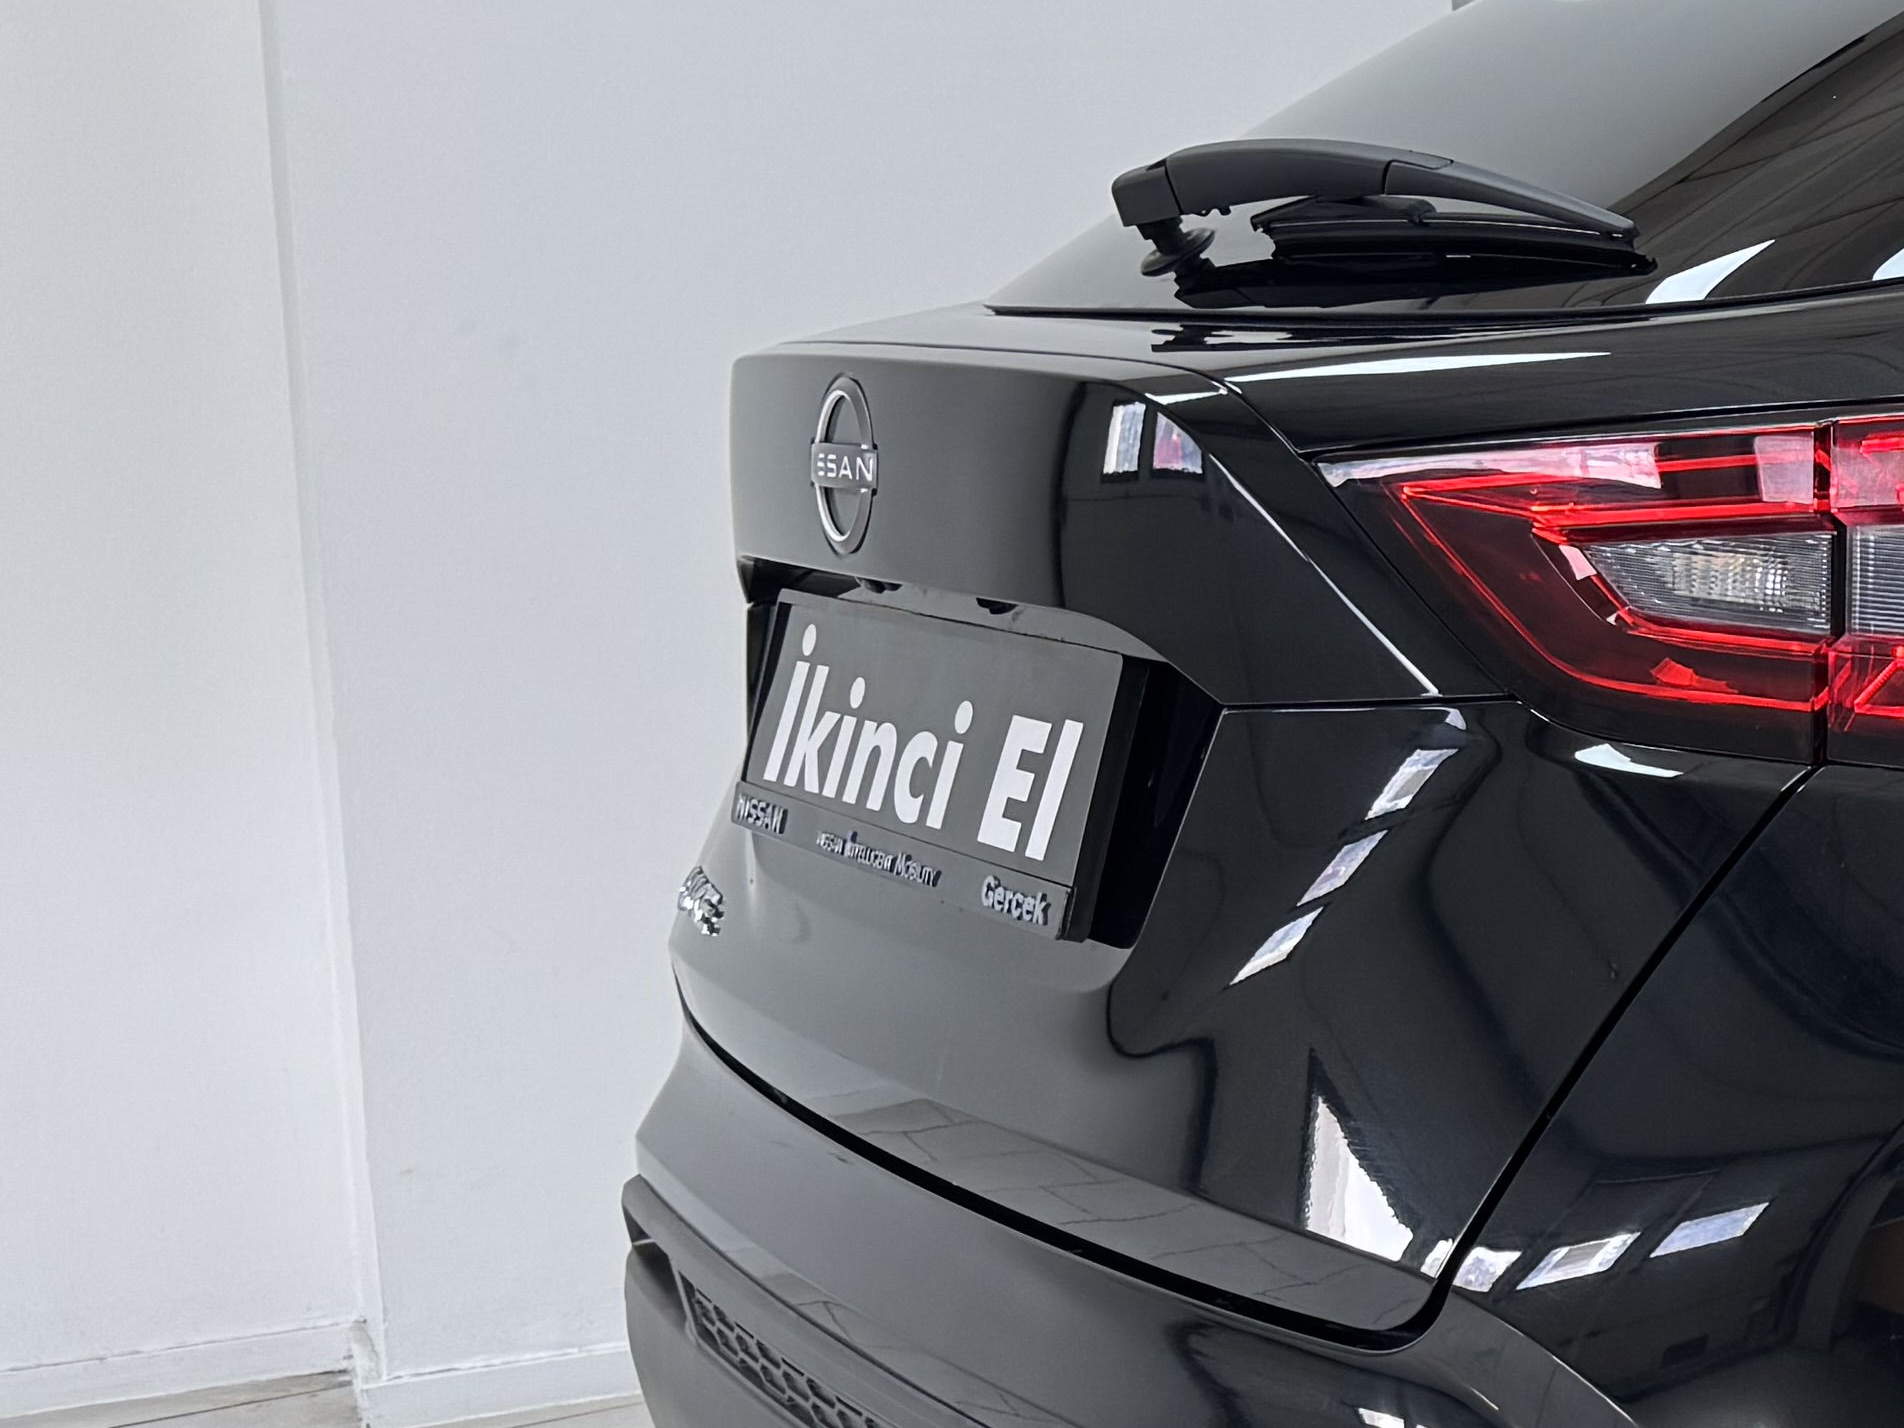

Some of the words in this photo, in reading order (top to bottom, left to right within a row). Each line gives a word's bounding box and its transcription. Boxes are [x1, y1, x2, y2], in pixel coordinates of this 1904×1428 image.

[763, 624, 974, 830] İkinci
[977, 714, 1085, 862] El
[735, 794, 788, 835] NISSAN
